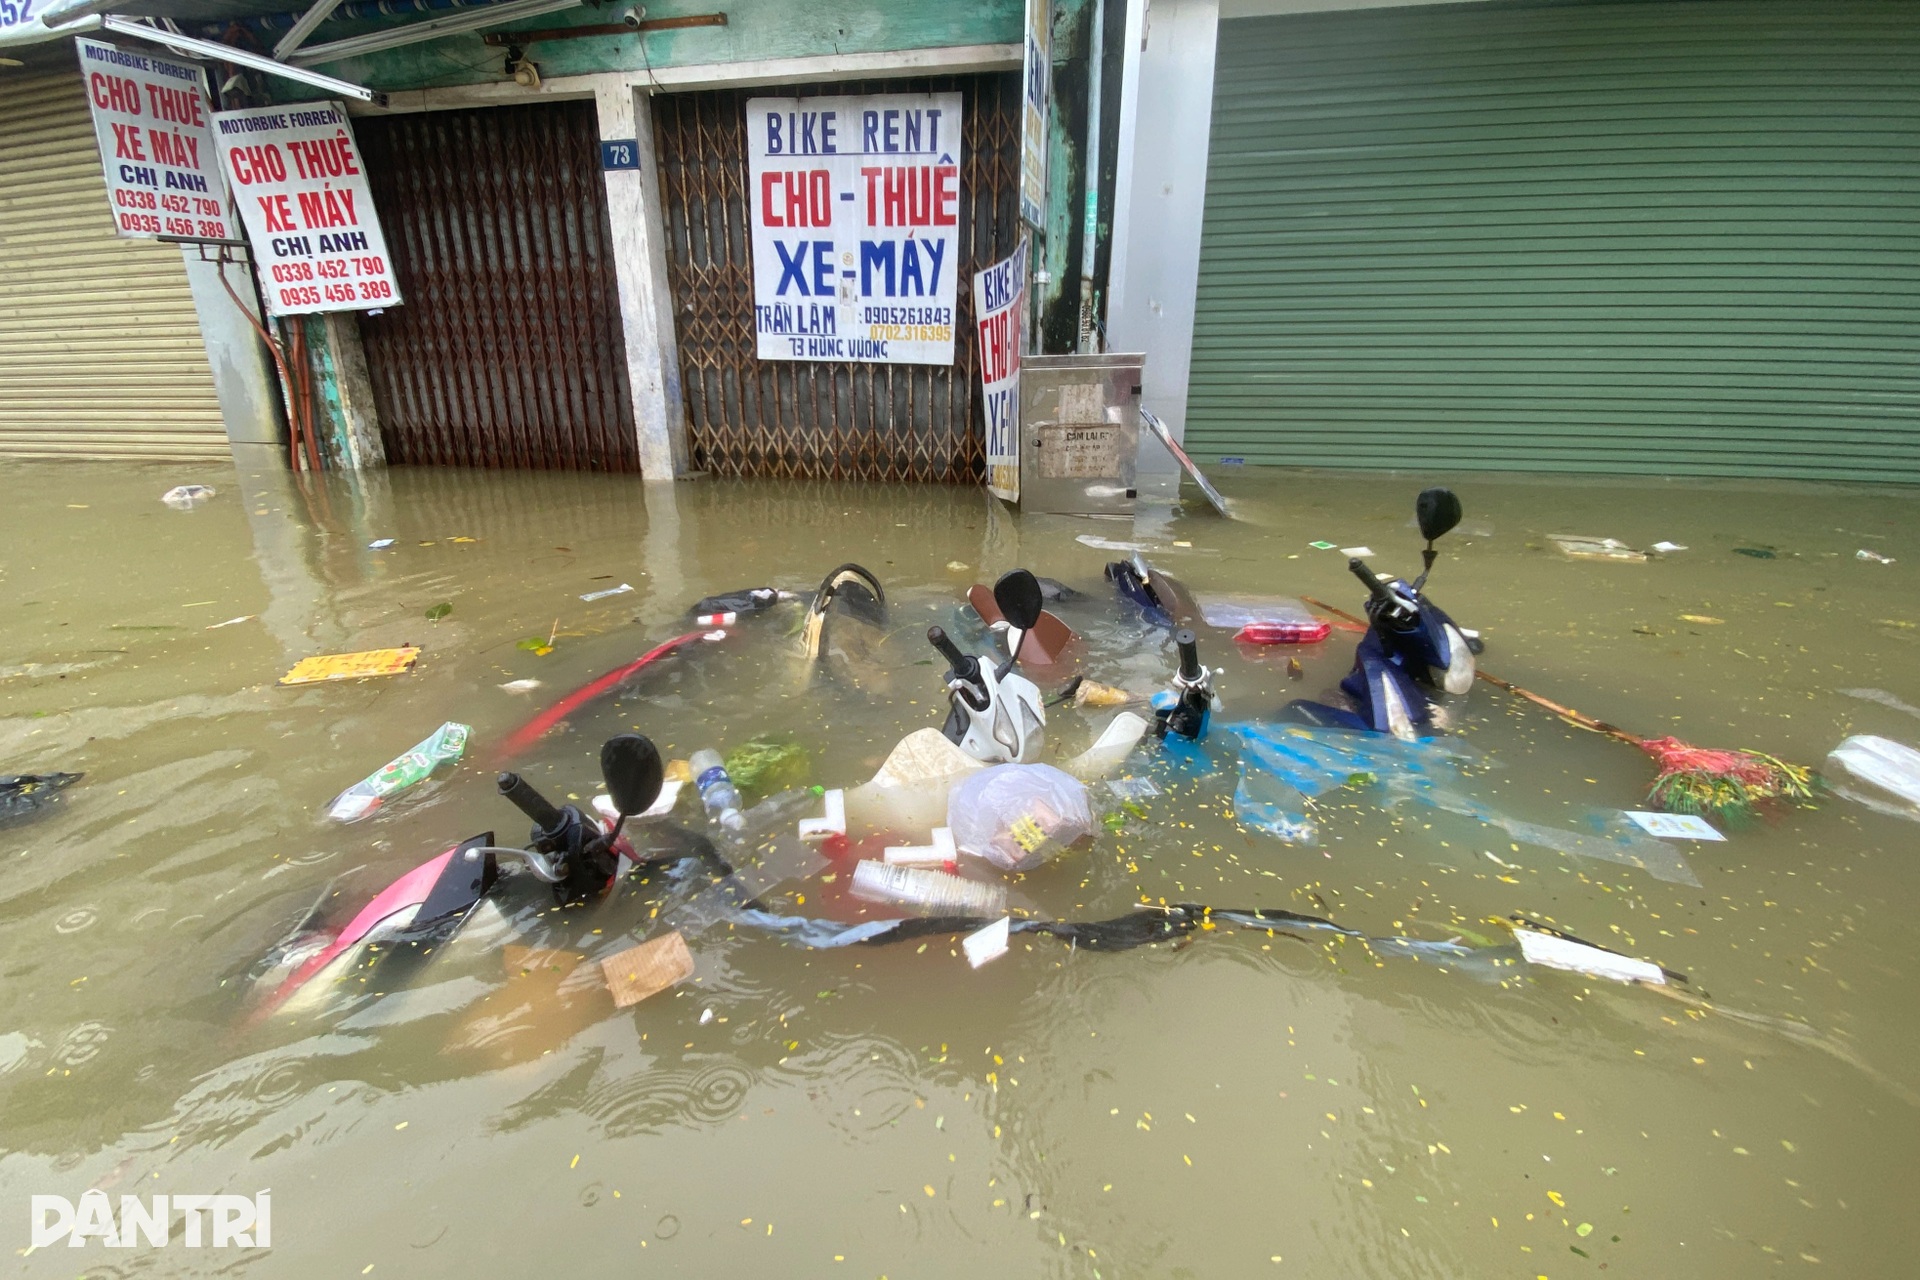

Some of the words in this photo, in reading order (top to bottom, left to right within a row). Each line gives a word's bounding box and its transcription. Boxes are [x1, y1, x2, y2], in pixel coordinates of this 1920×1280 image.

[85, 44, 150, 71] MOTORBIKE
[152, 60, 197, 82] FORRENT
[91, 72, 142, 116] CHO
[145, 83, 205, 128] THUÊ
[219, 114, 288, 134] MOTORBIKE
[767, 111, 837, 154] BIKE
[863, 109, 942, 152] RENT
[111, 122, 146, 161] XE
[148, 126, 200, 170] MÁY
[230, 143, 287, 186] CHO
[286, 129, 359, 179] THUÊ
[610, 145, 630, 165] 73
[119, 164, 159, 191] CHỊ
[165, 170, 208, 193] ANH
[116, 189, 157, 210] 0338
[161, 194, 190, 213] 452
[192, 197, 220, 217] 790
[257, 195, 297, 232] XE
[297, 182, 358, 229] MÁY
[120, 212, 161, 233] 0935
[166, 217, 194, 236] 456
[198, 220, 225, 238] 389
[272, 236, 313, 259] CHỊ
[320, 231, 369, 253] ANH
[272, 262, 314, 283] 0338
[317, 259, 350, 279] 452
[351, 256, 385, 276] 790
[280, 286, 321, 307] 0935
[325, 283, 356, 302] 456
[359, 280, 392, 300] 389
[788, 338, 804, 356] 73
[869, 325, 951, 342] 0702.316395
